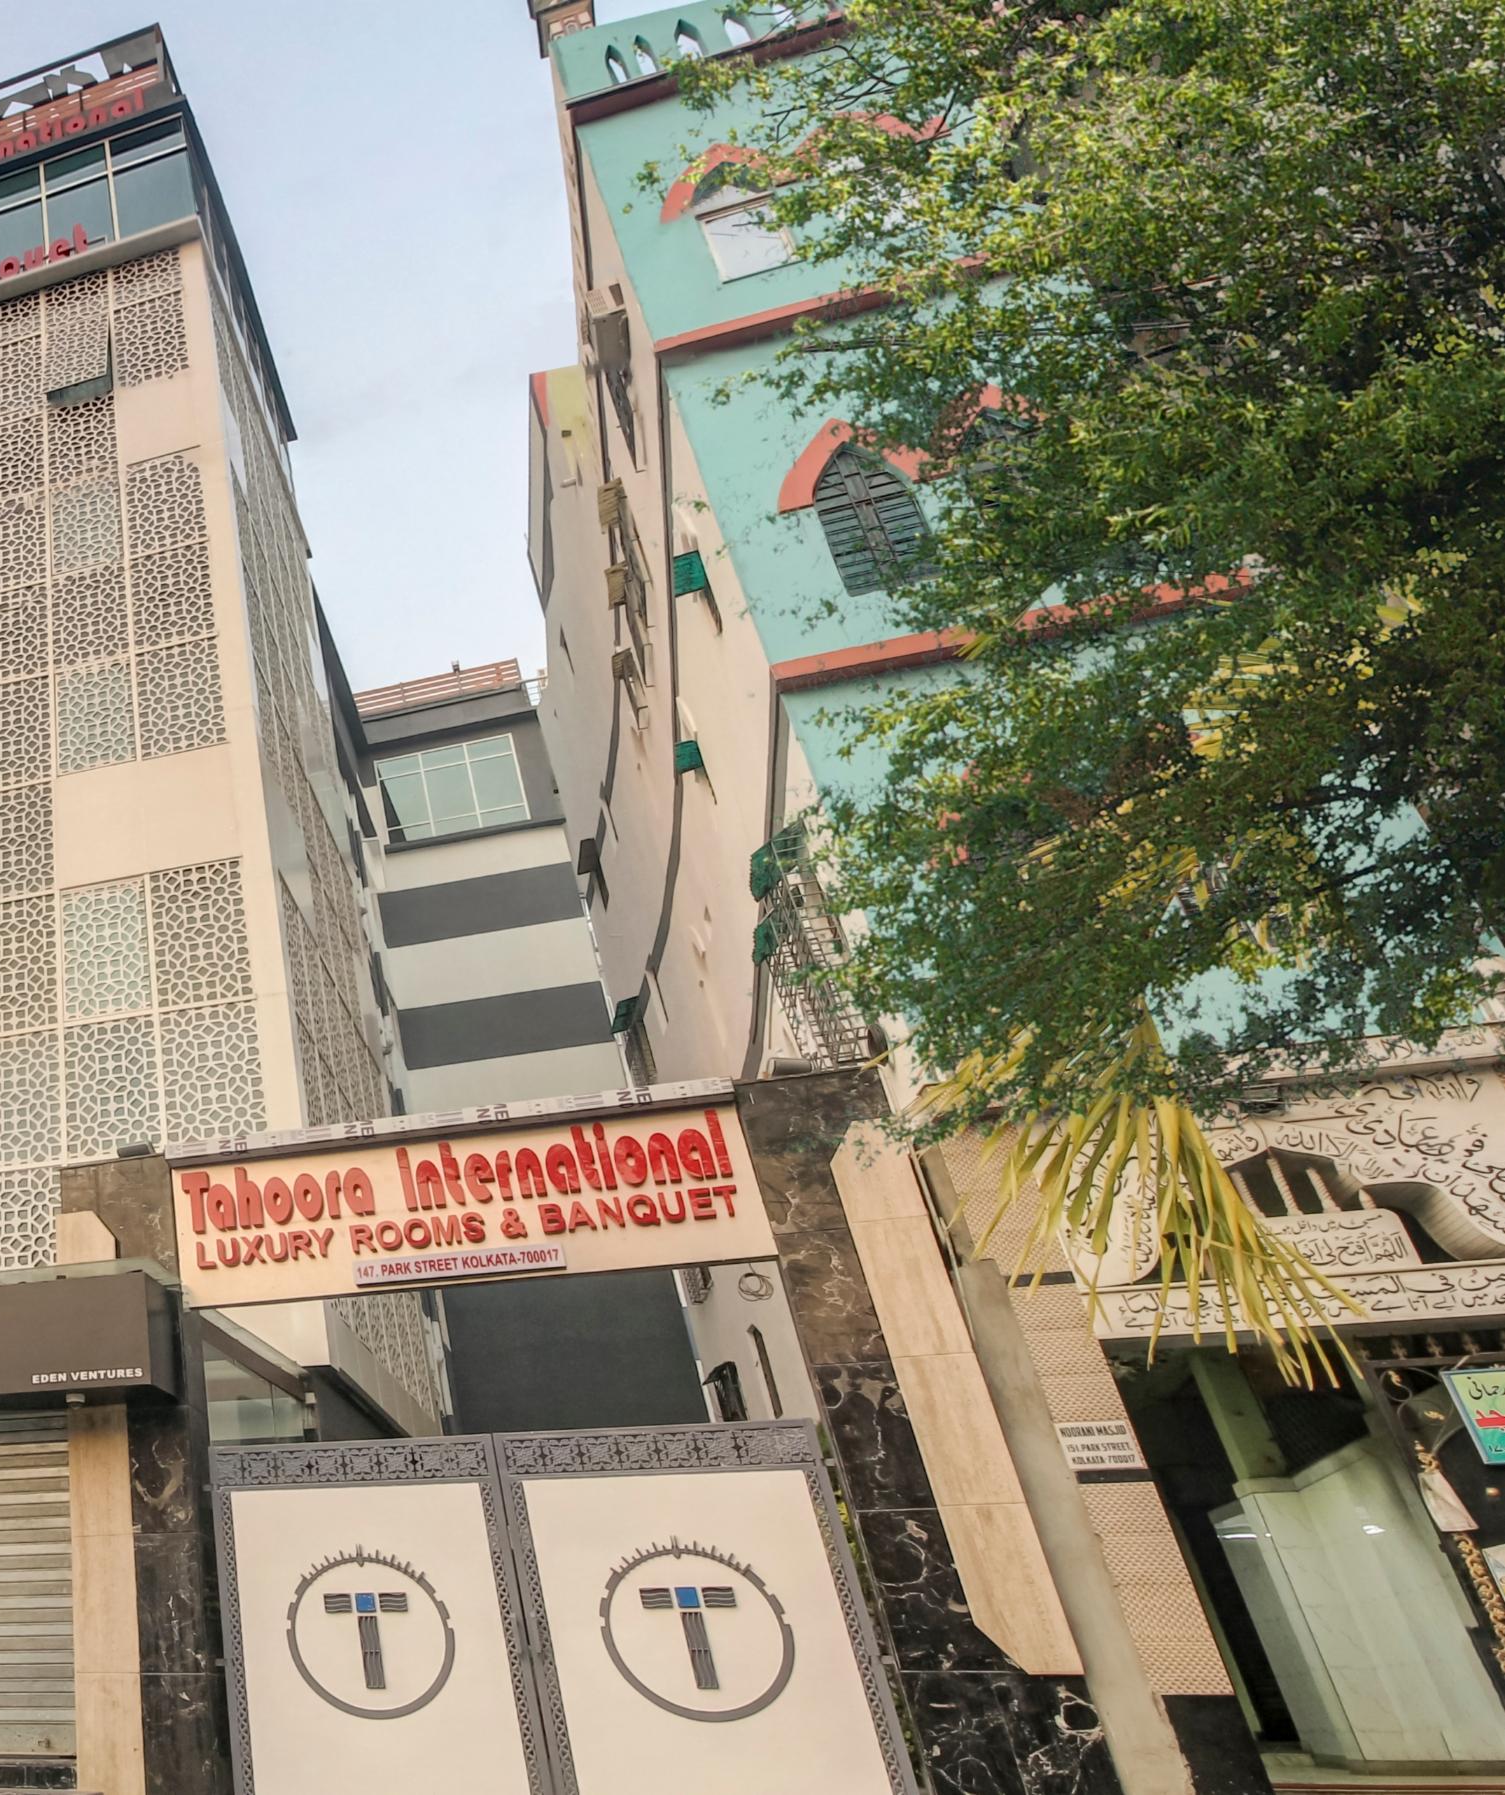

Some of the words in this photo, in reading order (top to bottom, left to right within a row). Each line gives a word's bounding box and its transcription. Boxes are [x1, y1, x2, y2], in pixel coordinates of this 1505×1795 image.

[180, 1166, 376, 1235] Tahoora
[396, 1109, 734, 1213] International
[196, 1227, 334, 1270] LUXURY
[349, 1211, 487, 1256] ROOMS
[500, 1207, 528, 1239] &
[538, 1184, 737, 1235] BANQUET
[381, 1261, 412, 1277] PARK
[414, 1256, 458, 1274] STREET
[462, 1248, 559, 1270] KOLKATA-700017
[32, 1372, 67, 1384] EDEN
[71, 1367, 143, 1381] VENTURES
[1059, 1426, 1096, 1437] NOORANI
[1096, 1424, 1127, 1436] MASJID
